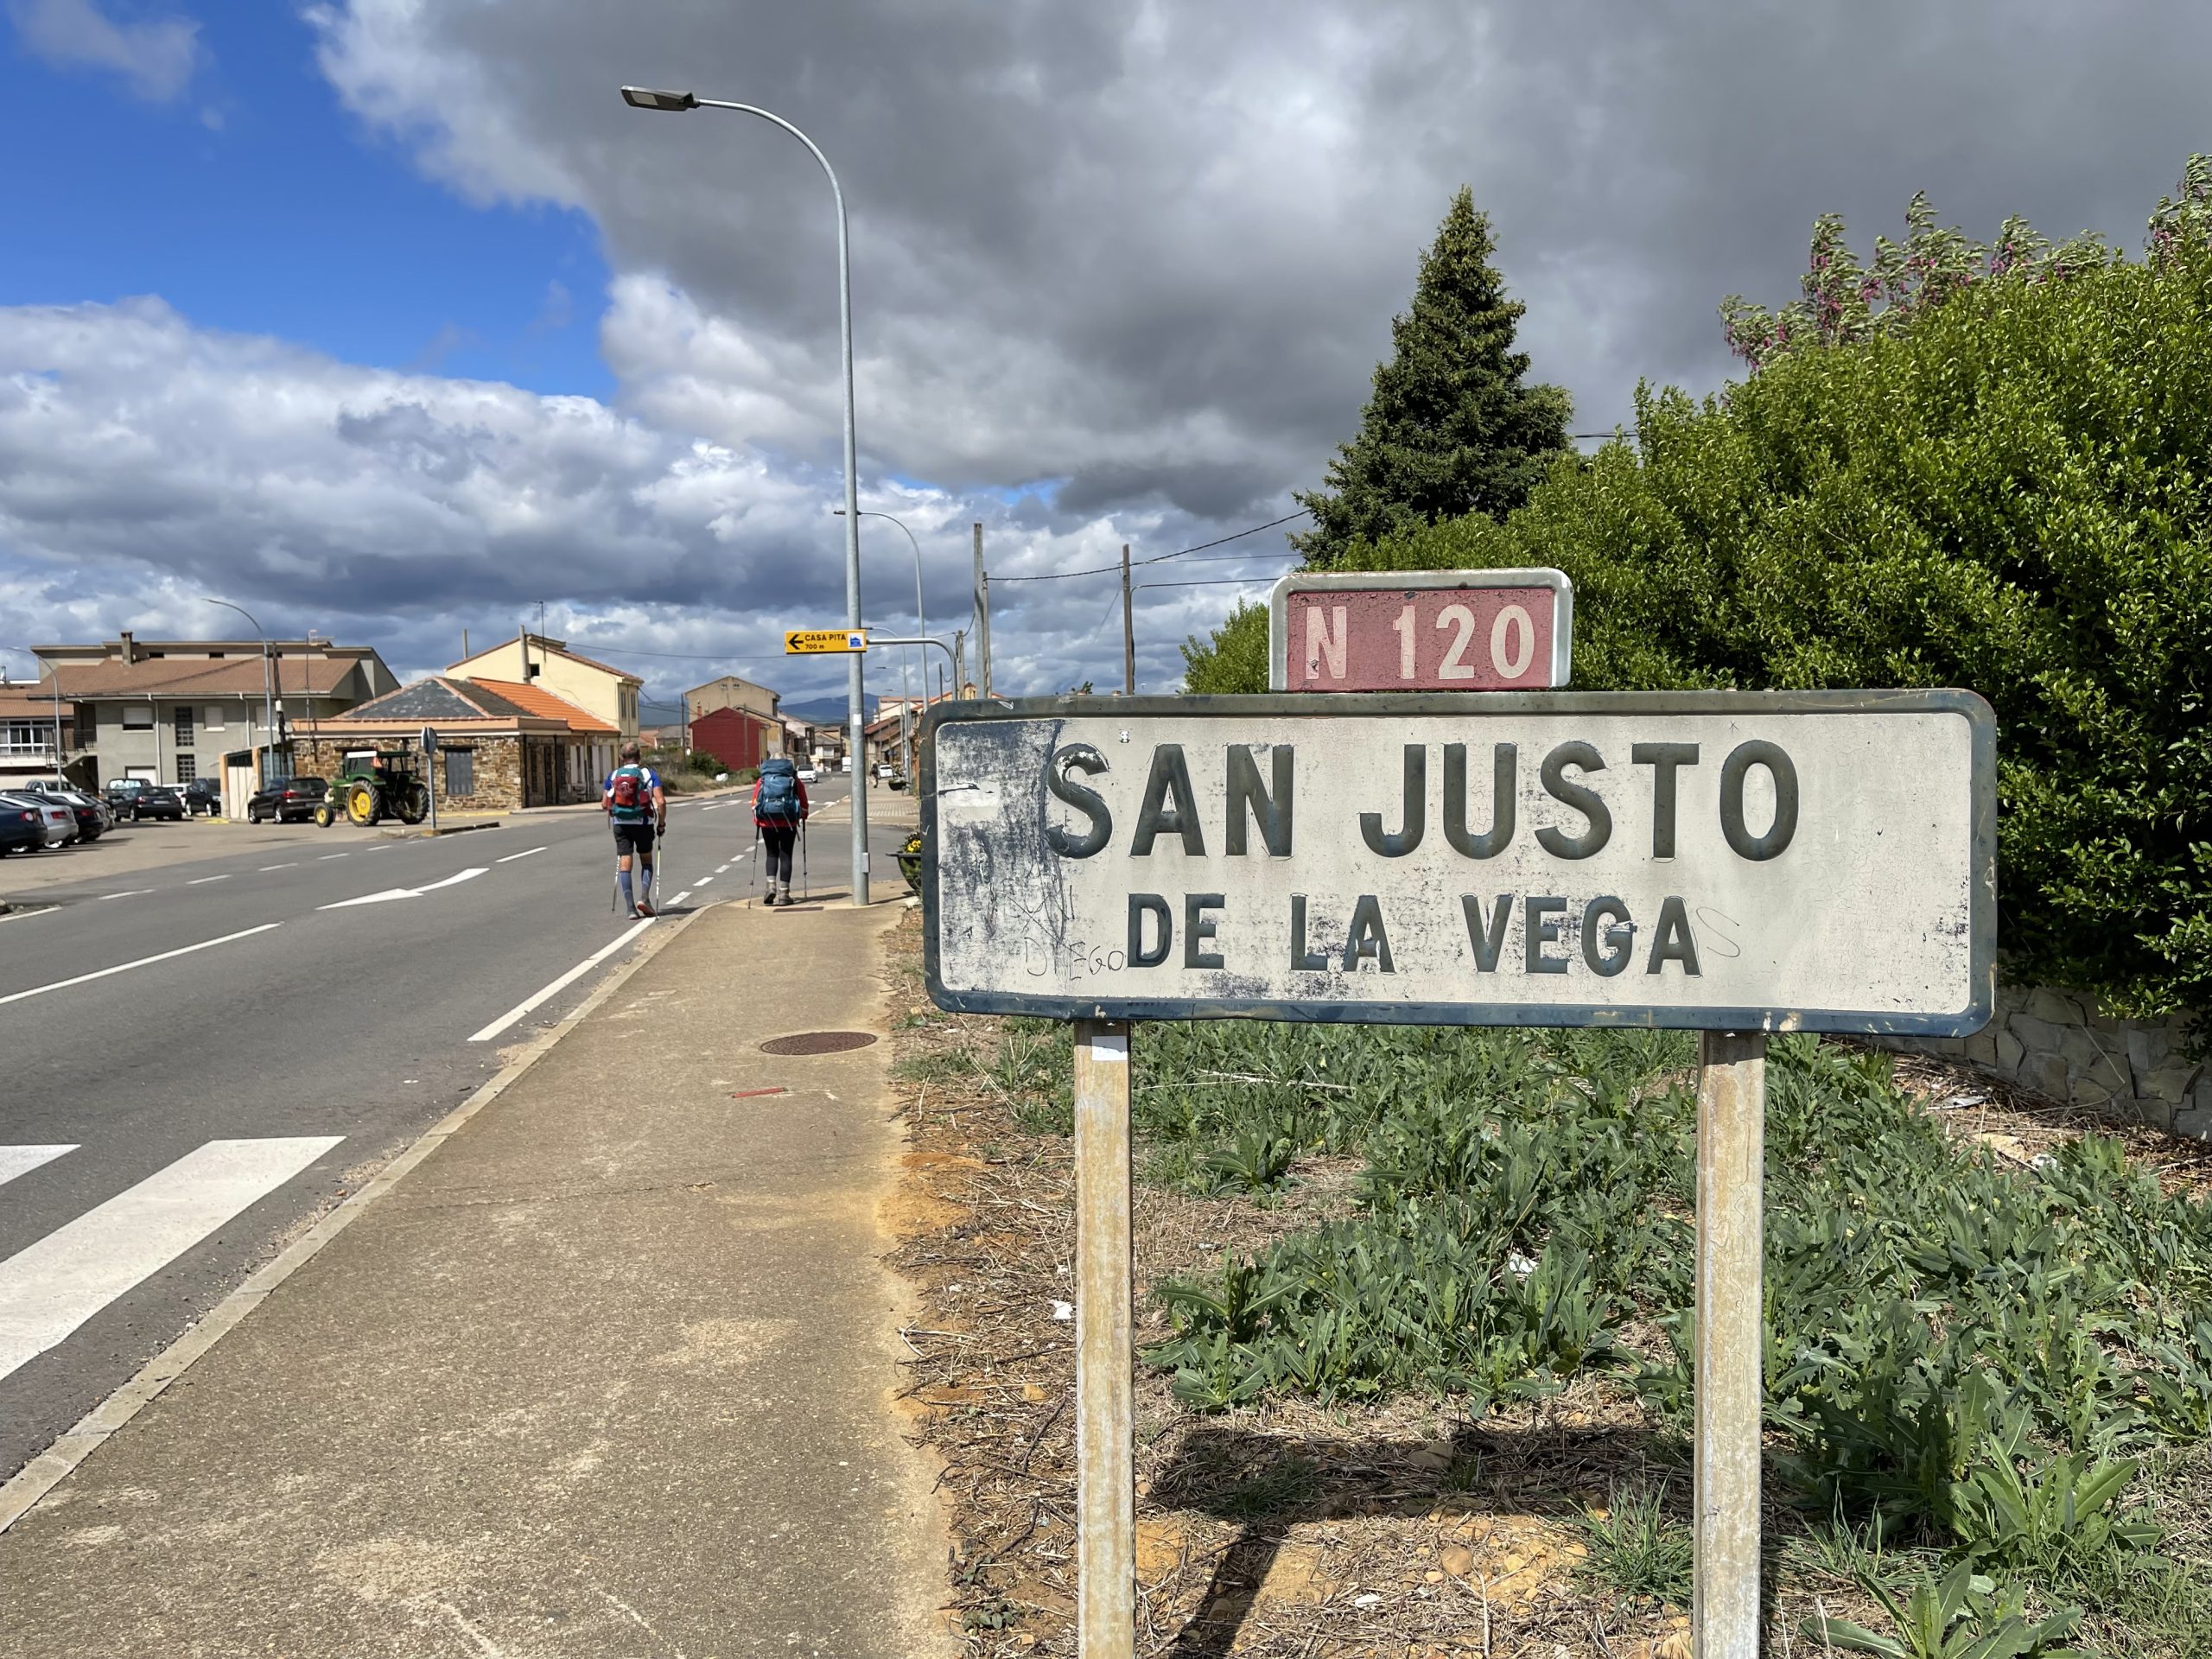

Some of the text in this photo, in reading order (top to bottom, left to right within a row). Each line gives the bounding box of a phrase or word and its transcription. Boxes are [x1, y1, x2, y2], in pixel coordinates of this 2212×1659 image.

[1306, 604, 1535, 680] N 120
[1046, 740, 1799, 861] SAN JUSTO
[1127, 893, 1702, 977] DE LA VEGA
